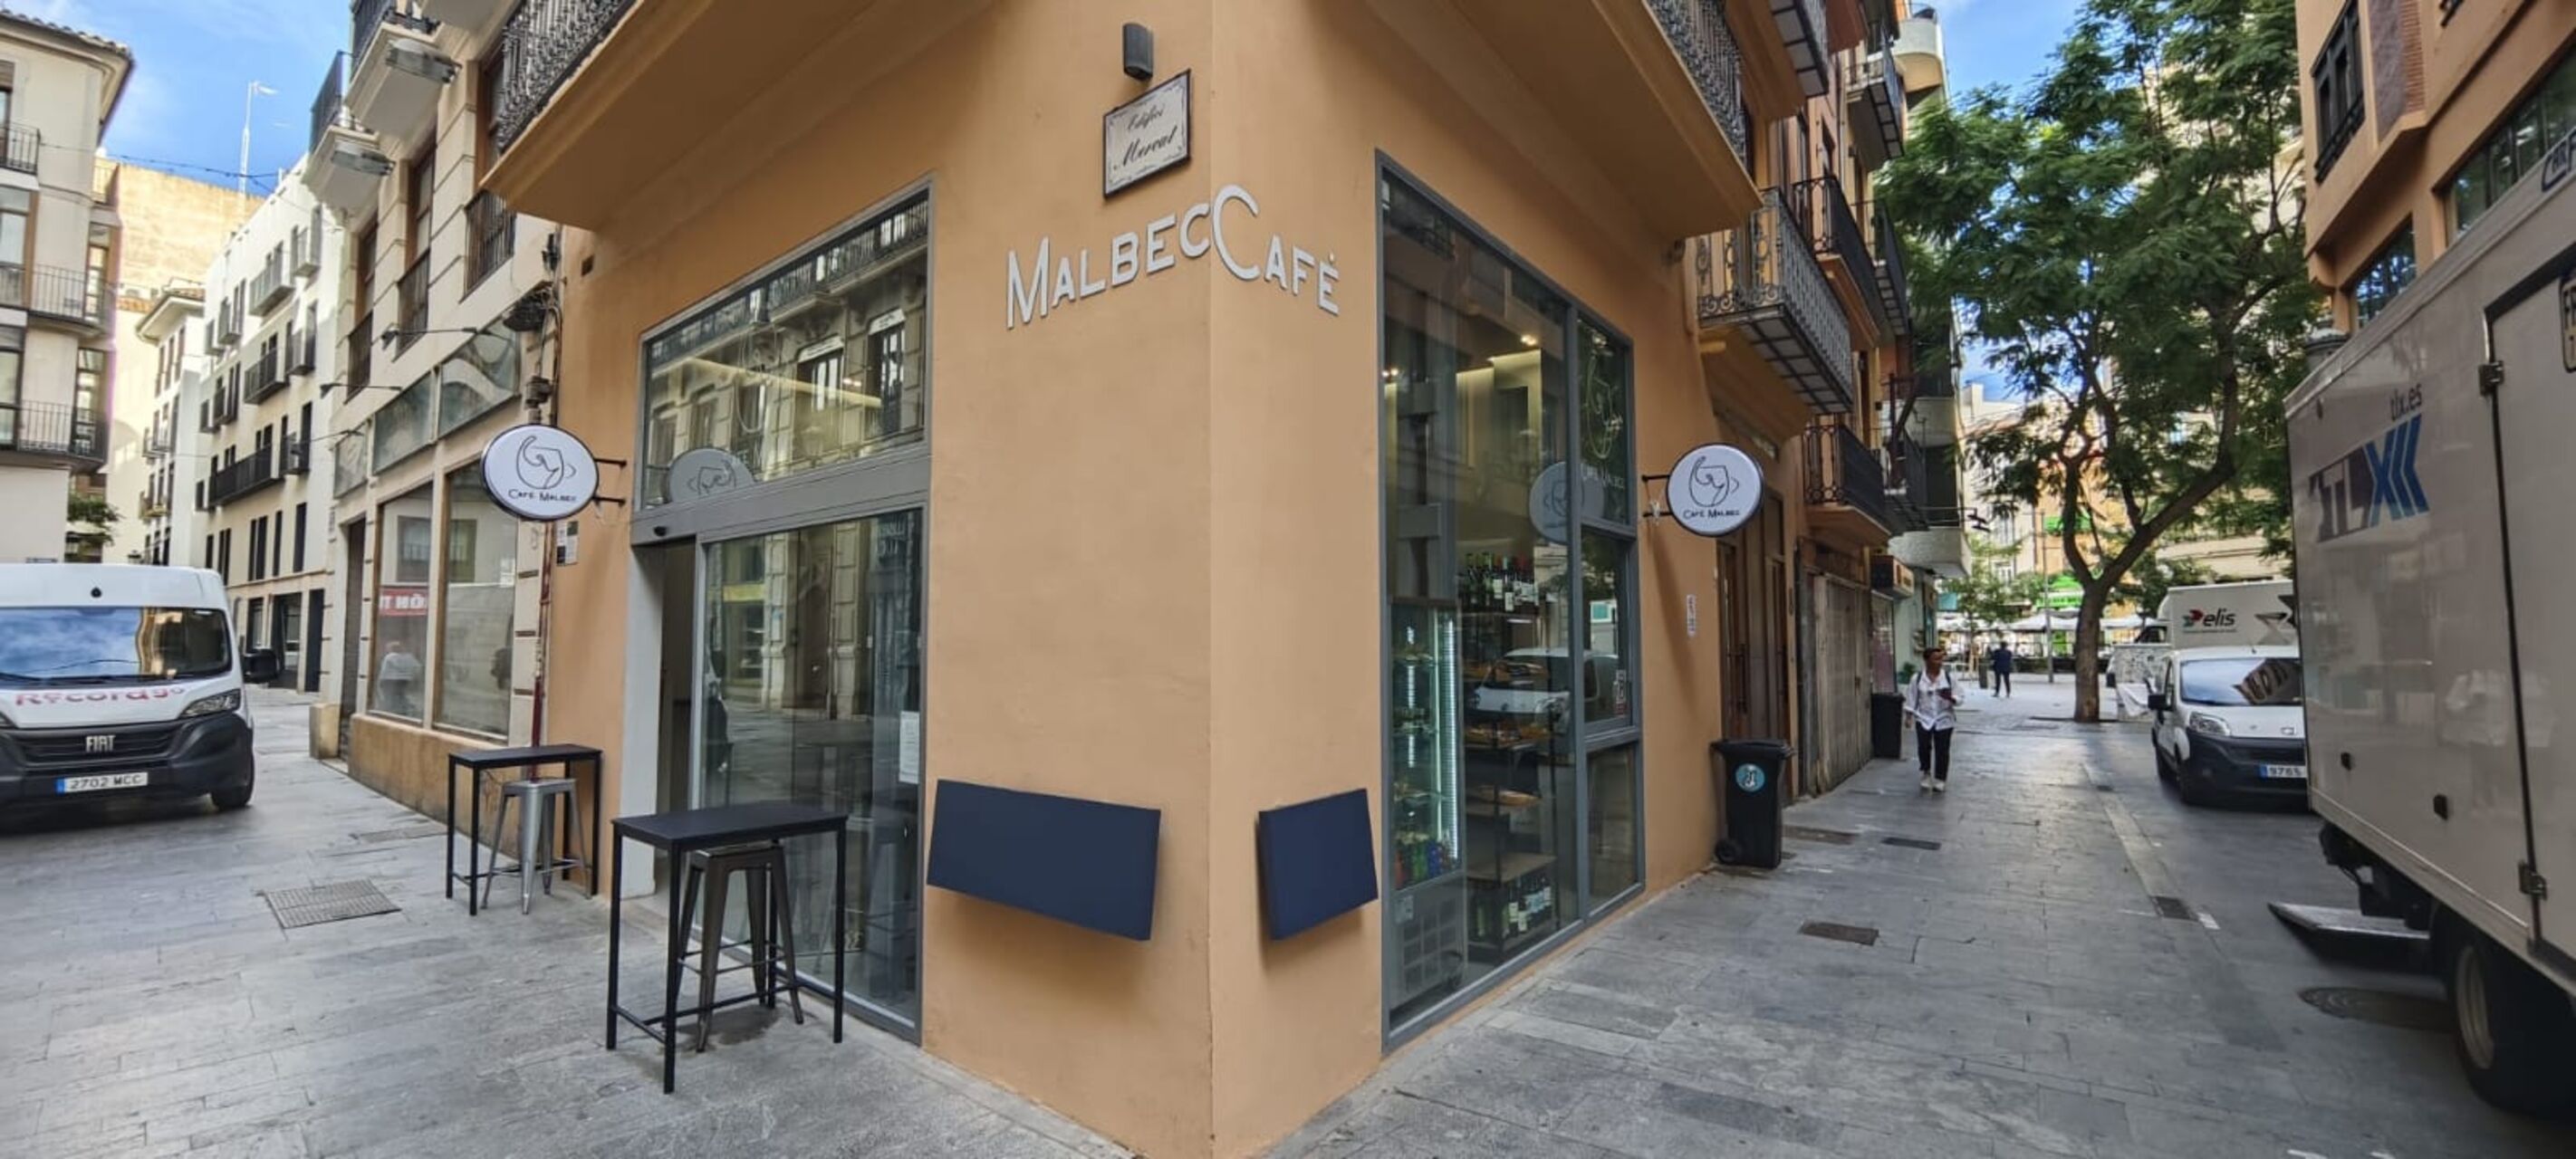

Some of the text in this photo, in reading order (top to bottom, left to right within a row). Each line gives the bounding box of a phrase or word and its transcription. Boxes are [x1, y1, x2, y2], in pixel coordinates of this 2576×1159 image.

[1006, 203, 1211, 330] MALBEC
[2203, 608, 2236, 627] elis
[85, 734, 116, 752] FIAT
[70, 774, 142, 790] 2702 MCC
